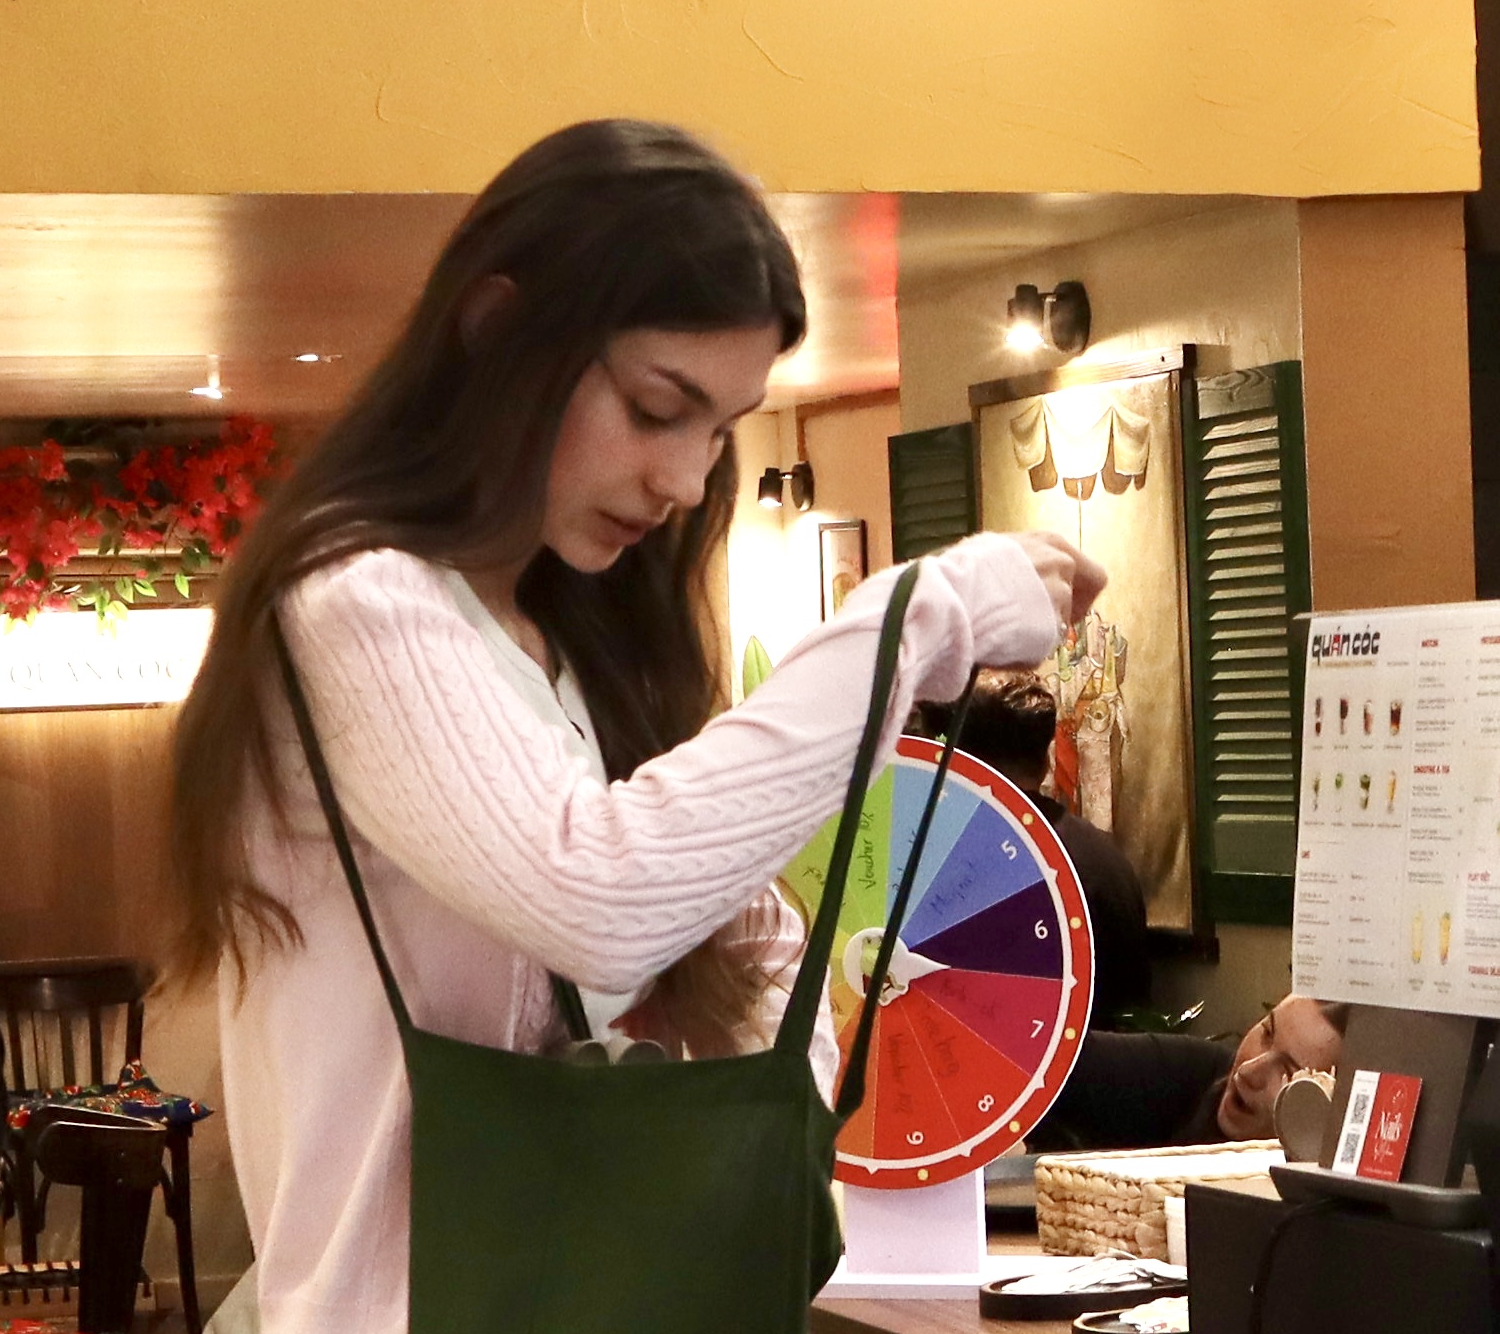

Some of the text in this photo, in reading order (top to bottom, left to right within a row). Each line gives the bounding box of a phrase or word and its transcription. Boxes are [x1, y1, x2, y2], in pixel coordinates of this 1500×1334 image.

[1000, 840, 1018, 862] 5
[1034, 920, 1050, 940] 6
[1030, 1020, 1045, 1038] 7
[978, 1094, 995, 1112] 8
